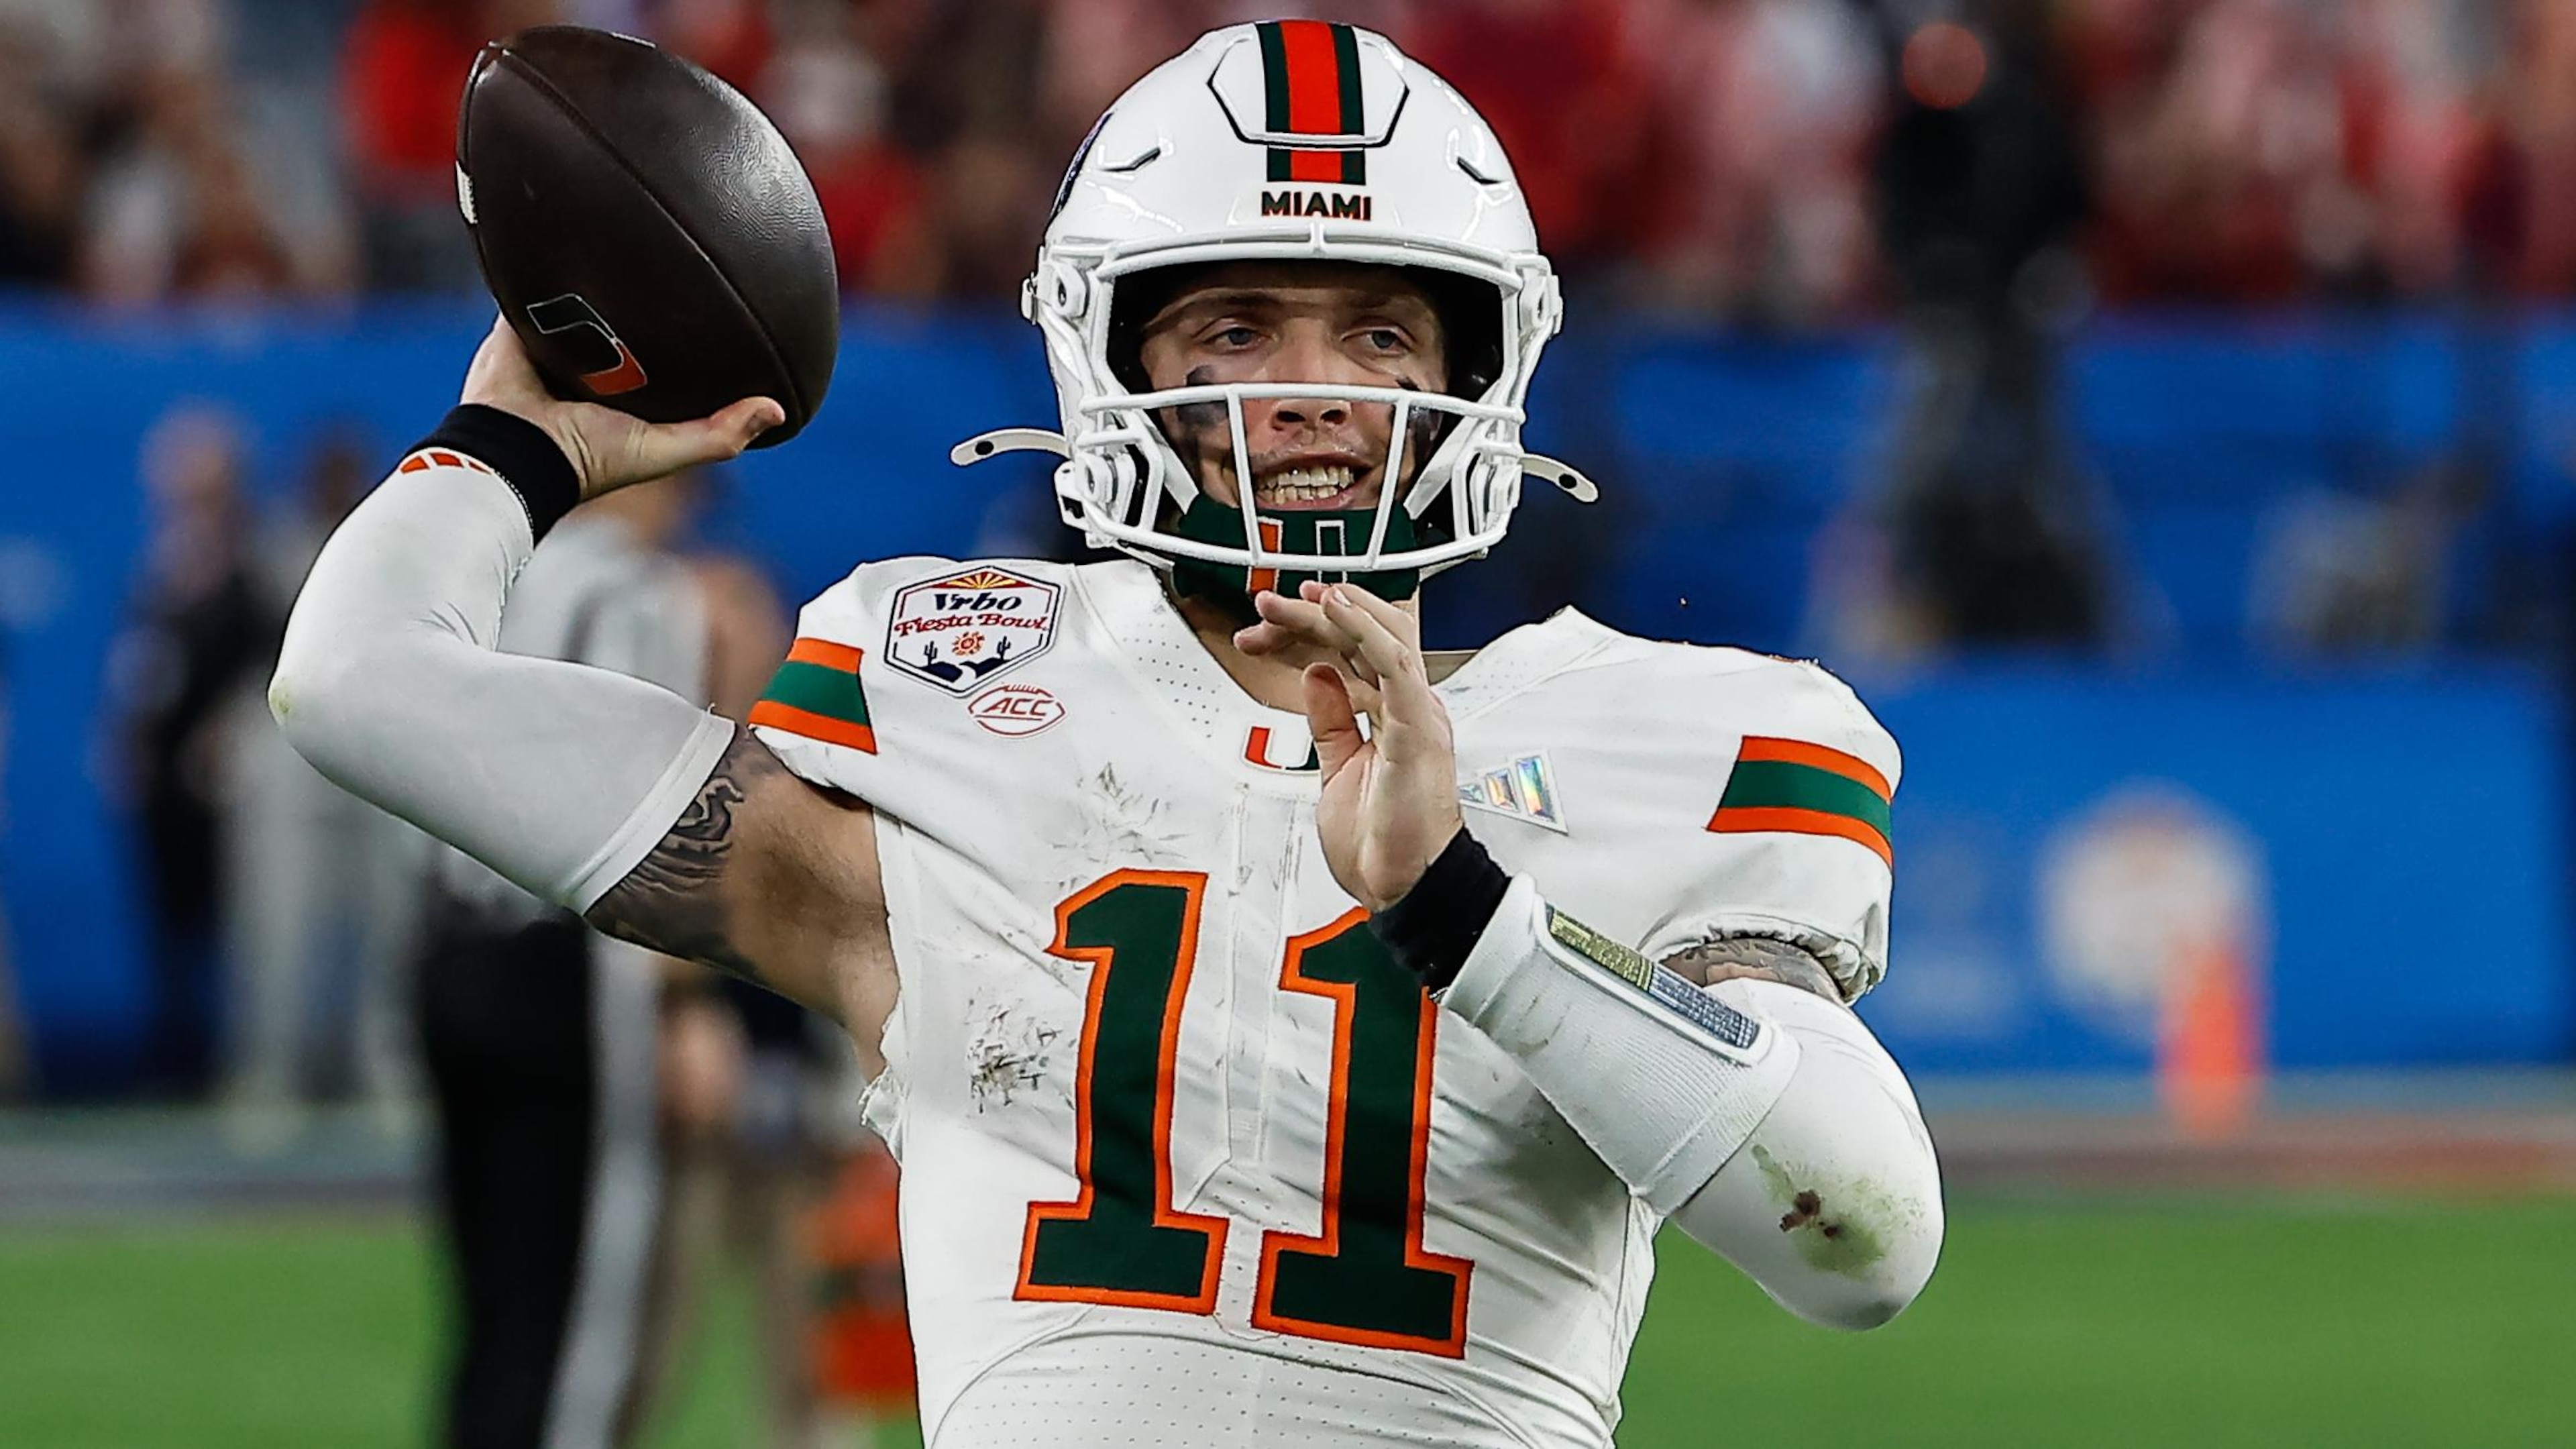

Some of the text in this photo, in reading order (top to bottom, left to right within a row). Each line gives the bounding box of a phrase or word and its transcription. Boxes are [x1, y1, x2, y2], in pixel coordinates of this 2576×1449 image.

[1261, 191, 1371, 221] MIAMI
[934, 592, 1022, 610] Vrbo
[894, 613, 1048, 637] Fiesta Bowl
[983, 697, 1053, 716] ACC
[1013, 867, 1474, 1359] 11
